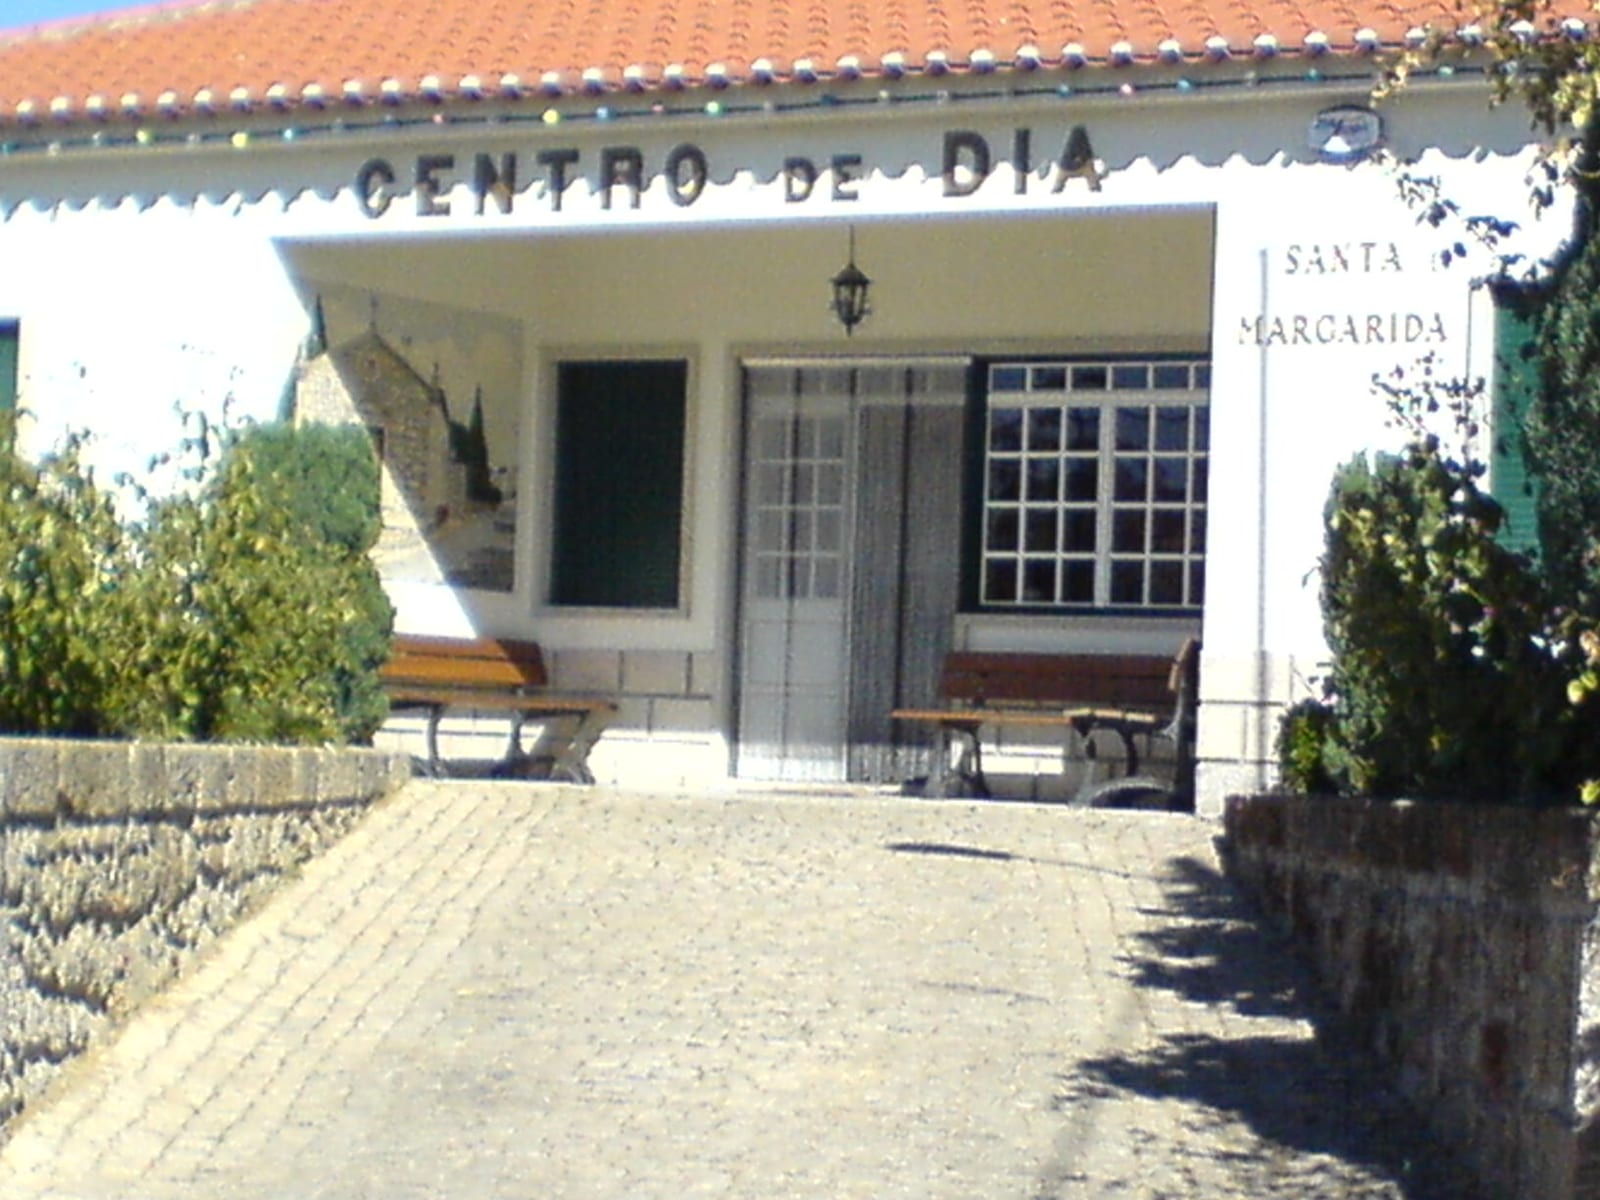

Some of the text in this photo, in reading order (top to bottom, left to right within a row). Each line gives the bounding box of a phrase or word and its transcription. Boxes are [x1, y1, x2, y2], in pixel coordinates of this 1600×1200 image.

[355, 123, 1103, 220] CENTRO DE DIA
[1284, 241, 1403, 275] SANTA
[1238, 312, 1449, 345] MARGARIDA
